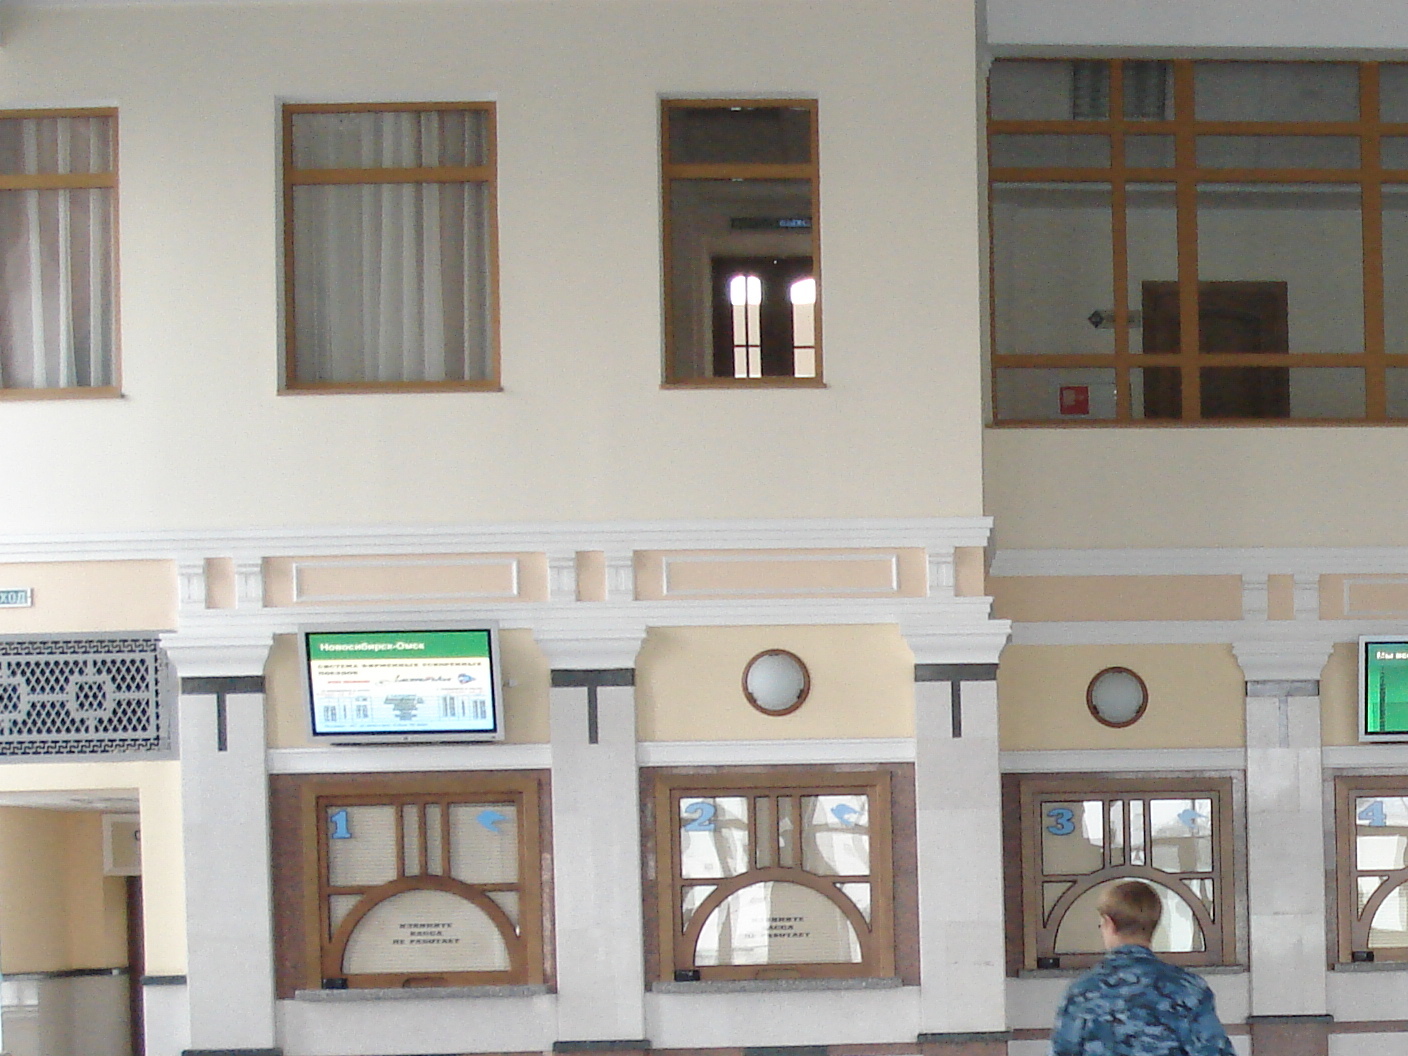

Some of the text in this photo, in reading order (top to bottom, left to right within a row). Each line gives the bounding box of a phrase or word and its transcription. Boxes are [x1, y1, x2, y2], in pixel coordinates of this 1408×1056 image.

[320, 642, 425, 652] Новосибирск-Омск
[1376, 651, 1394, 660] Мы
[330, 809, 352, 839] 1
[684, 802, 716, 832] 2
[1047, 808, 1075, 836] 3
[1358, 800, 1386, 827] 4
